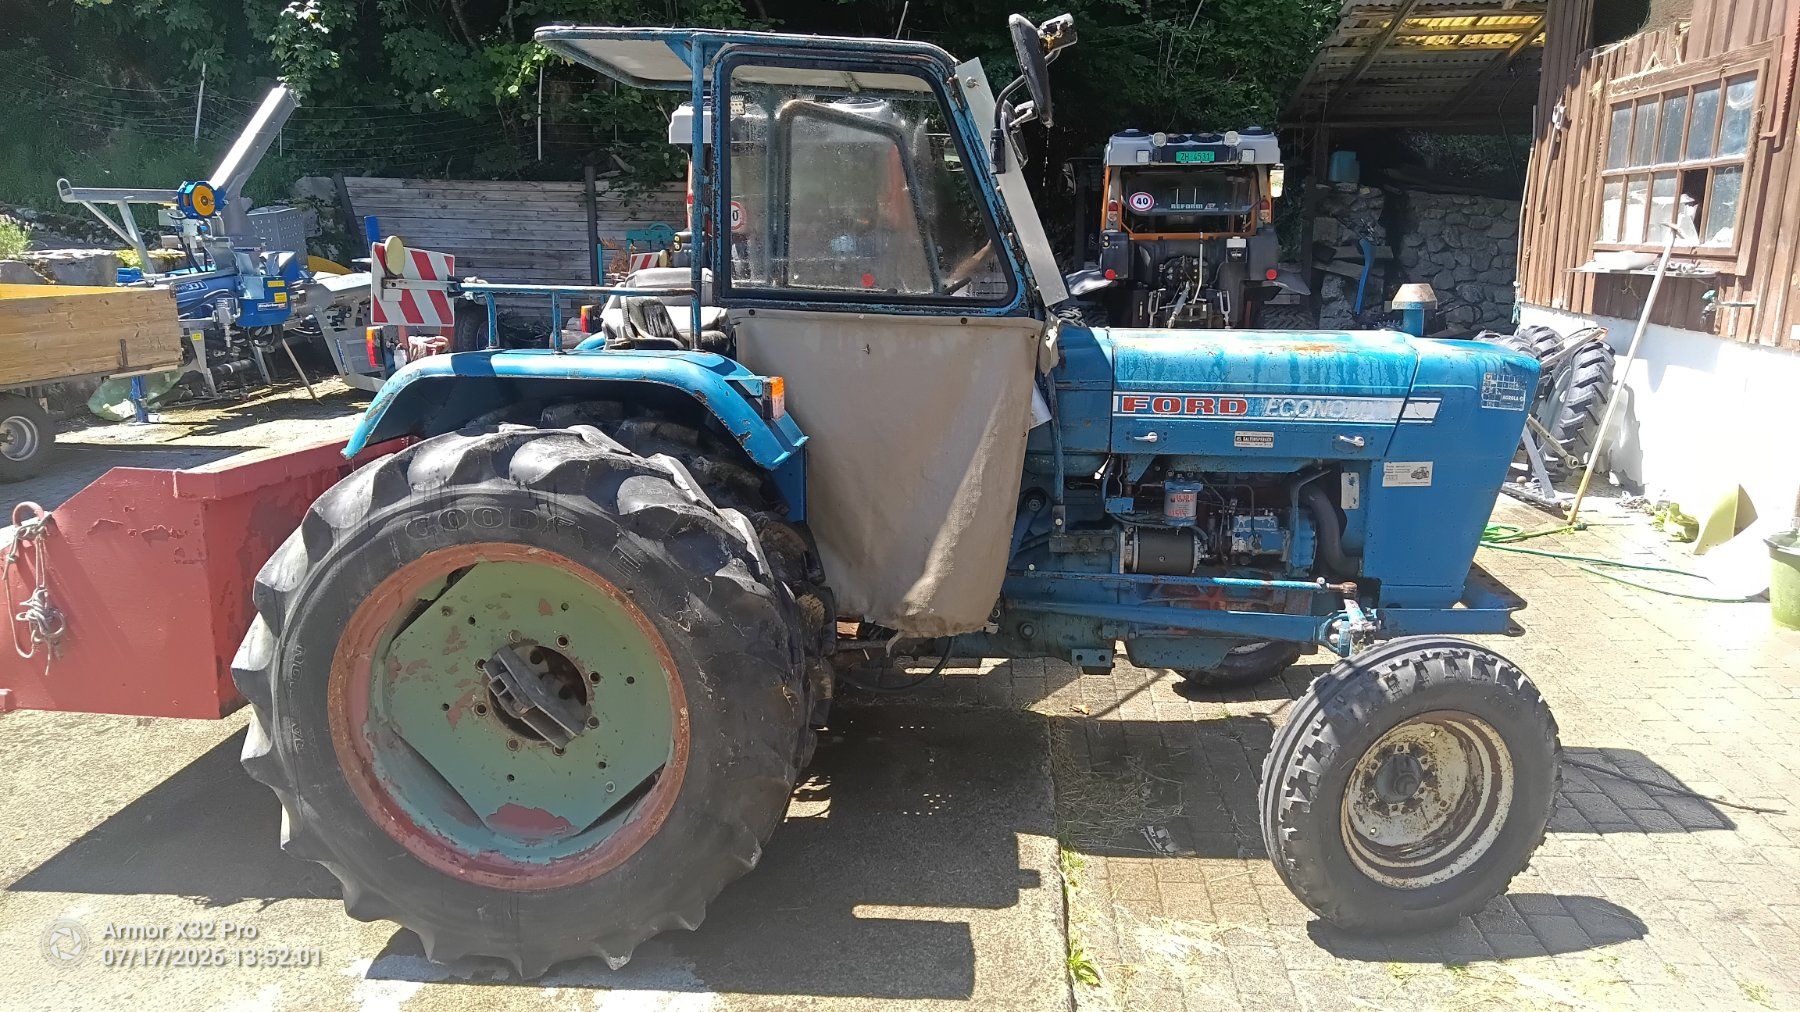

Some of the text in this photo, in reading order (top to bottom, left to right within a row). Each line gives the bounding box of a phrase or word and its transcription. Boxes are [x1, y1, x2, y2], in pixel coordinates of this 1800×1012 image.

[1136, 197, 1149, 205] 40
[186, 281, 204, 291] 331
[1121, 396, 1248, 415] FORD
